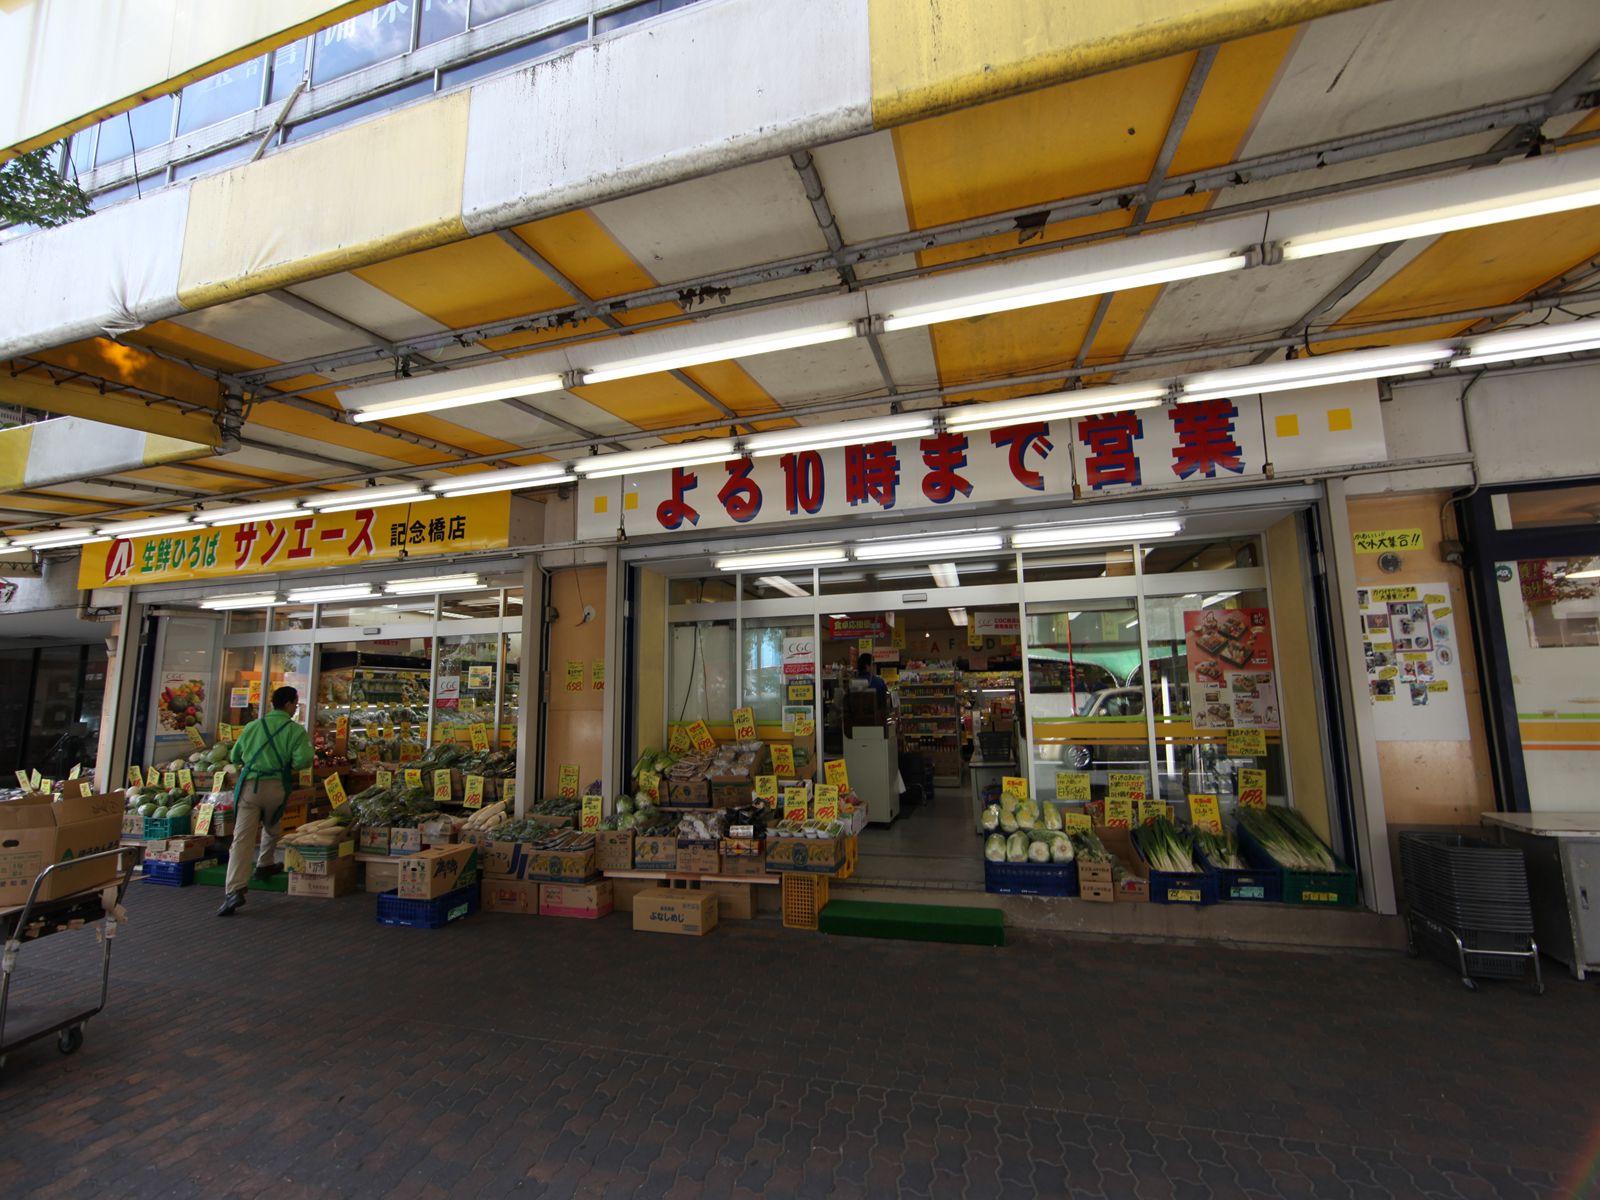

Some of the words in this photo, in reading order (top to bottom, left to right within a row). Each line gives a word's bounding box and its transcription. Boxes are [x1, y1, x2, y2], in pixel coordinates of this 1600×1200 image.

[656, 398, 1246, 530] よる10時まで営業
[140, 531, 220, 574] 生鮮ひろば
[234, 508, 377, 570] サンエース
[390, 515, 467, 547] 記念橋店
[787, 642, 811, 653] CGC
[440, 680, 457, 690] CGC
[649, 911, 685, 923] ぶなしめじ
